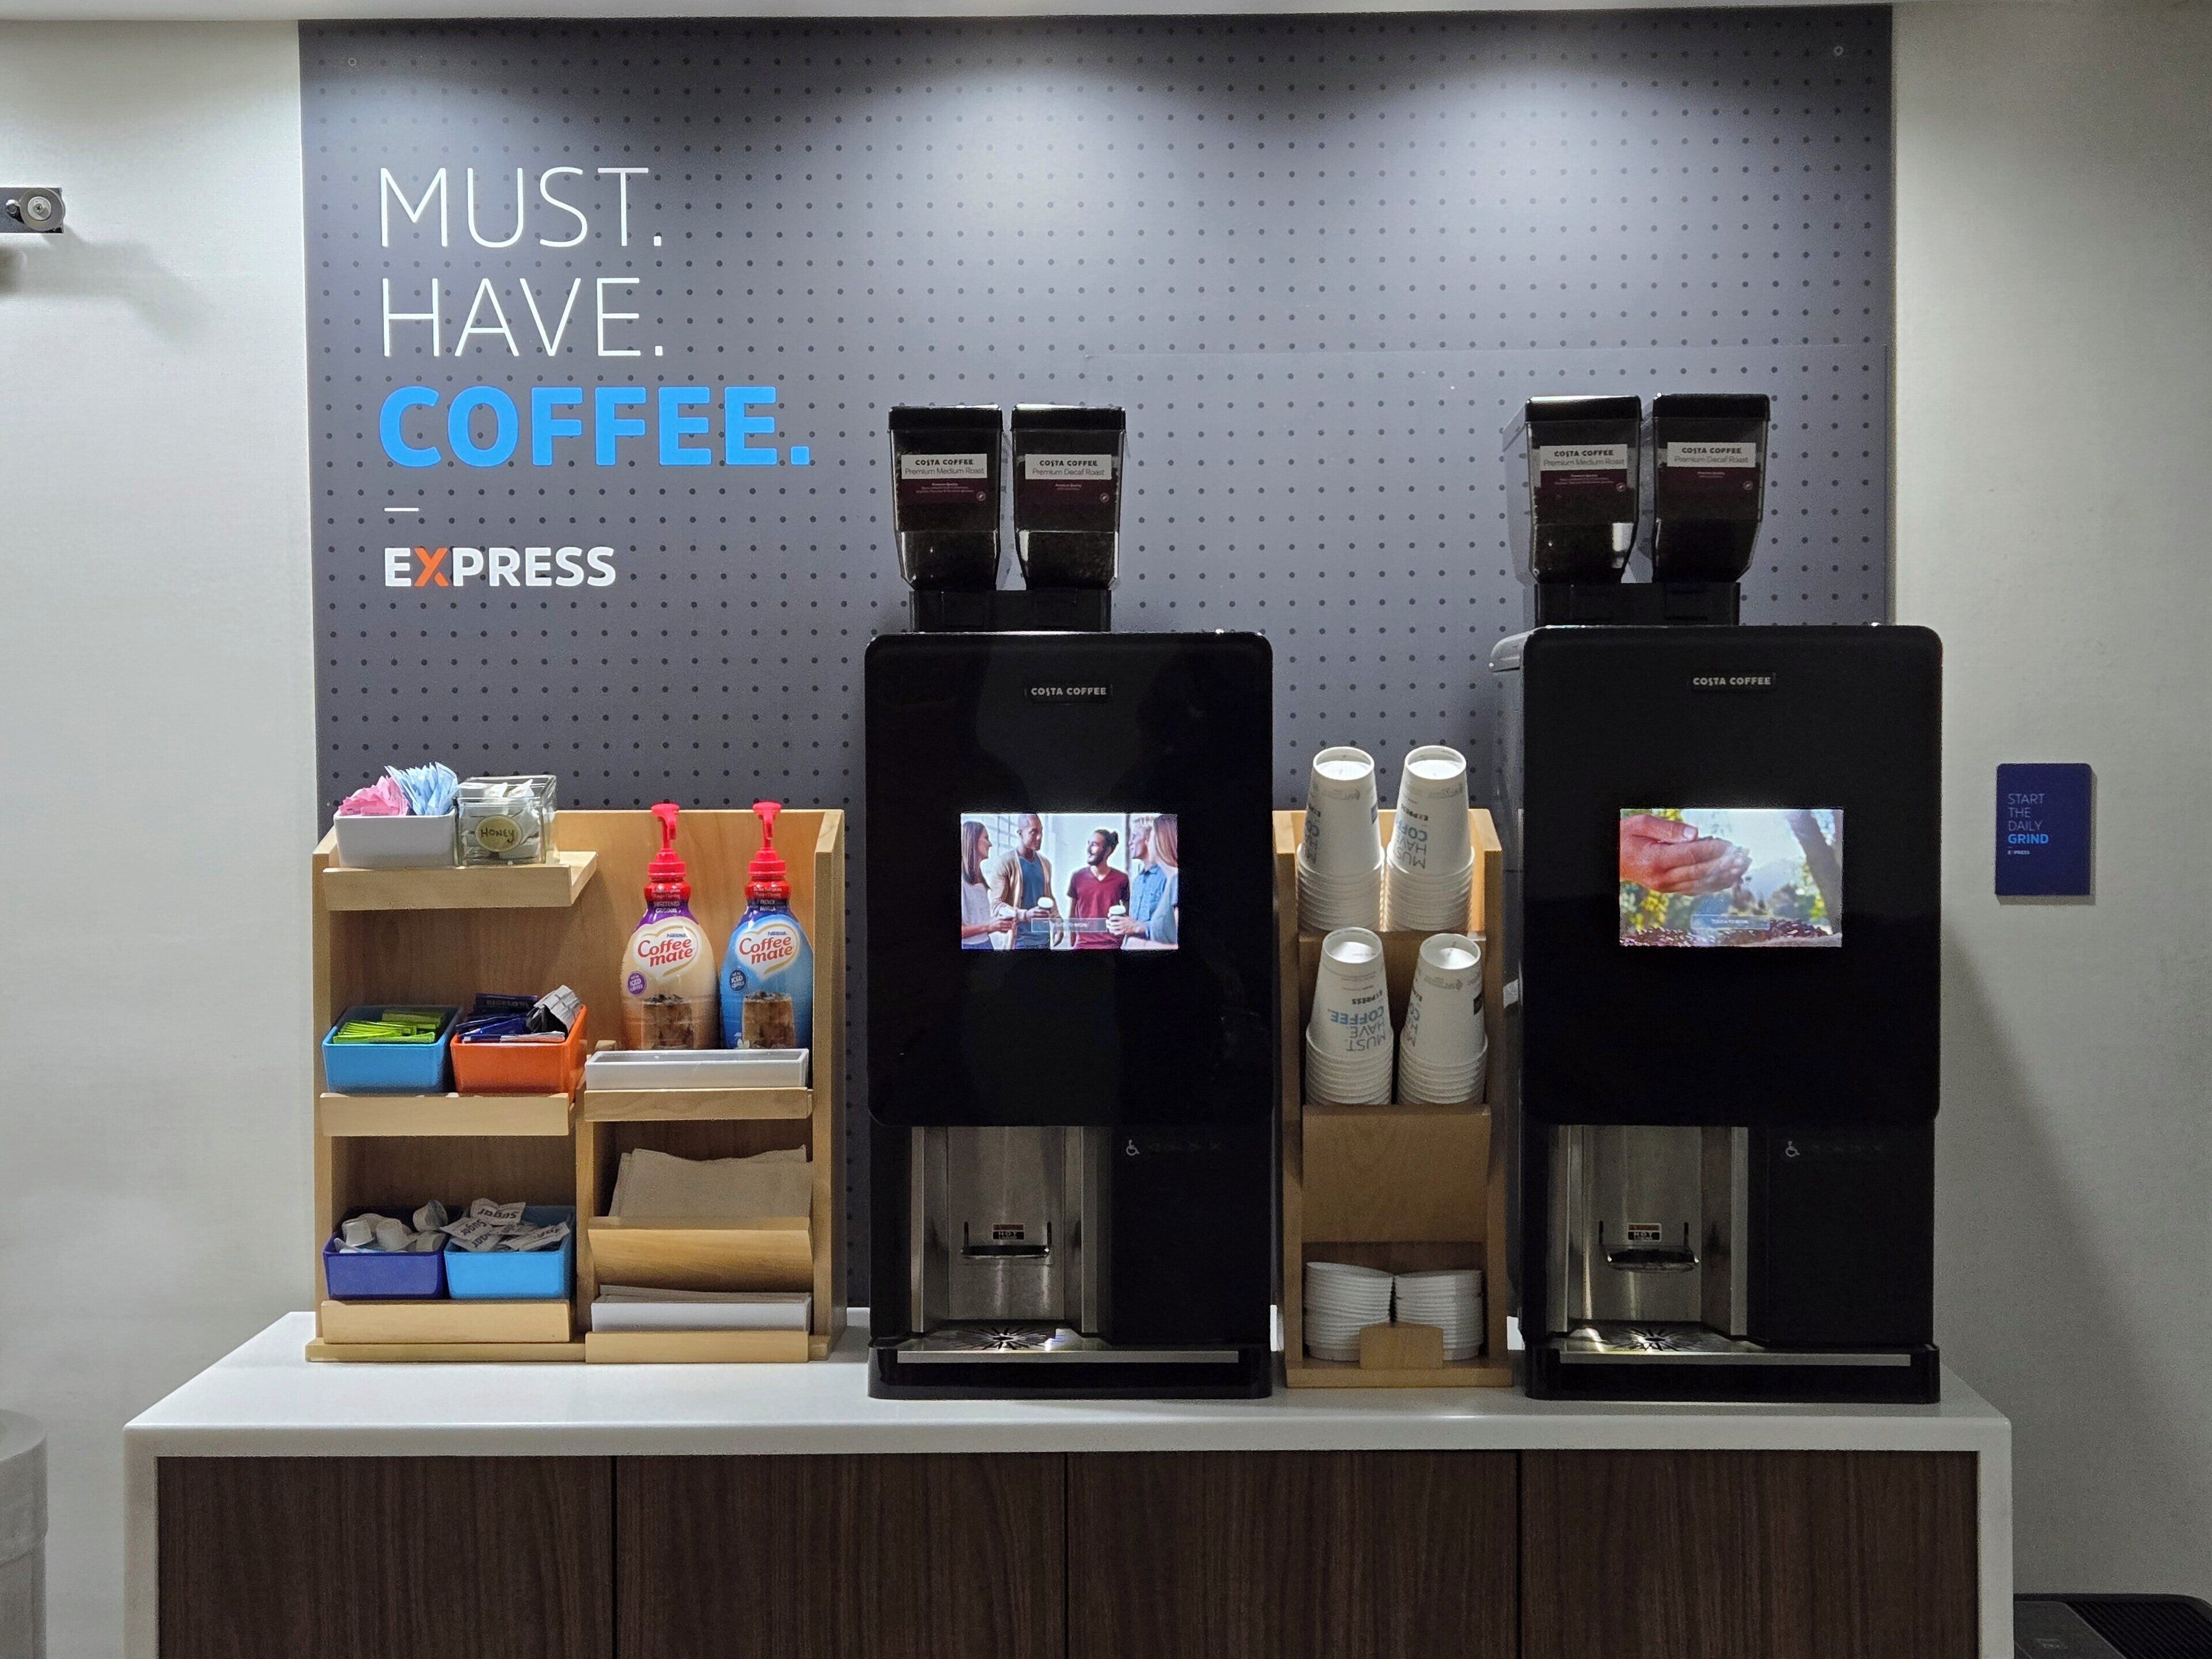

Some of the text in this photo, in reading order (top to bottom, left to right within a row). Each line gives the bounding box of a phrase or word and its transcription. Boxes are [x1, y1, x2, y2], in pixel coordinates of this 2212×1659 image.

[380, 166, 663, 248] MUST.
[383, 277, 664, 358] HAVE.
[378, 385, 811, 468] COFFEE.
[915, 459, 941, 467] COSTA
[905, 467, 985, 476] Premium Medium Roast
[1032, 468, 1063, 476] Premium
[1064, 468, 1084, 476] Decaf
[384, 546, 616, 588] EXPRESS
[1692, 676, 1771, 686] COSTA COFFEE
[1031, 687, 1107, 696] COSTA COFFEE
[2008, 793, 2046, 805] START
[2008, 807, 2032, 818] THE
[2008, 820, 2043, 831] DAILY
[2008, 833, 2050, 844] GRIND
[638, 938, 691, 958] Coffee
[739, 937, 791, 955] Coffee
[650, 948, 694, 967] mate
[751, 946, 793, 965] mate
[477, 1209, 520, 1219] Sugar
